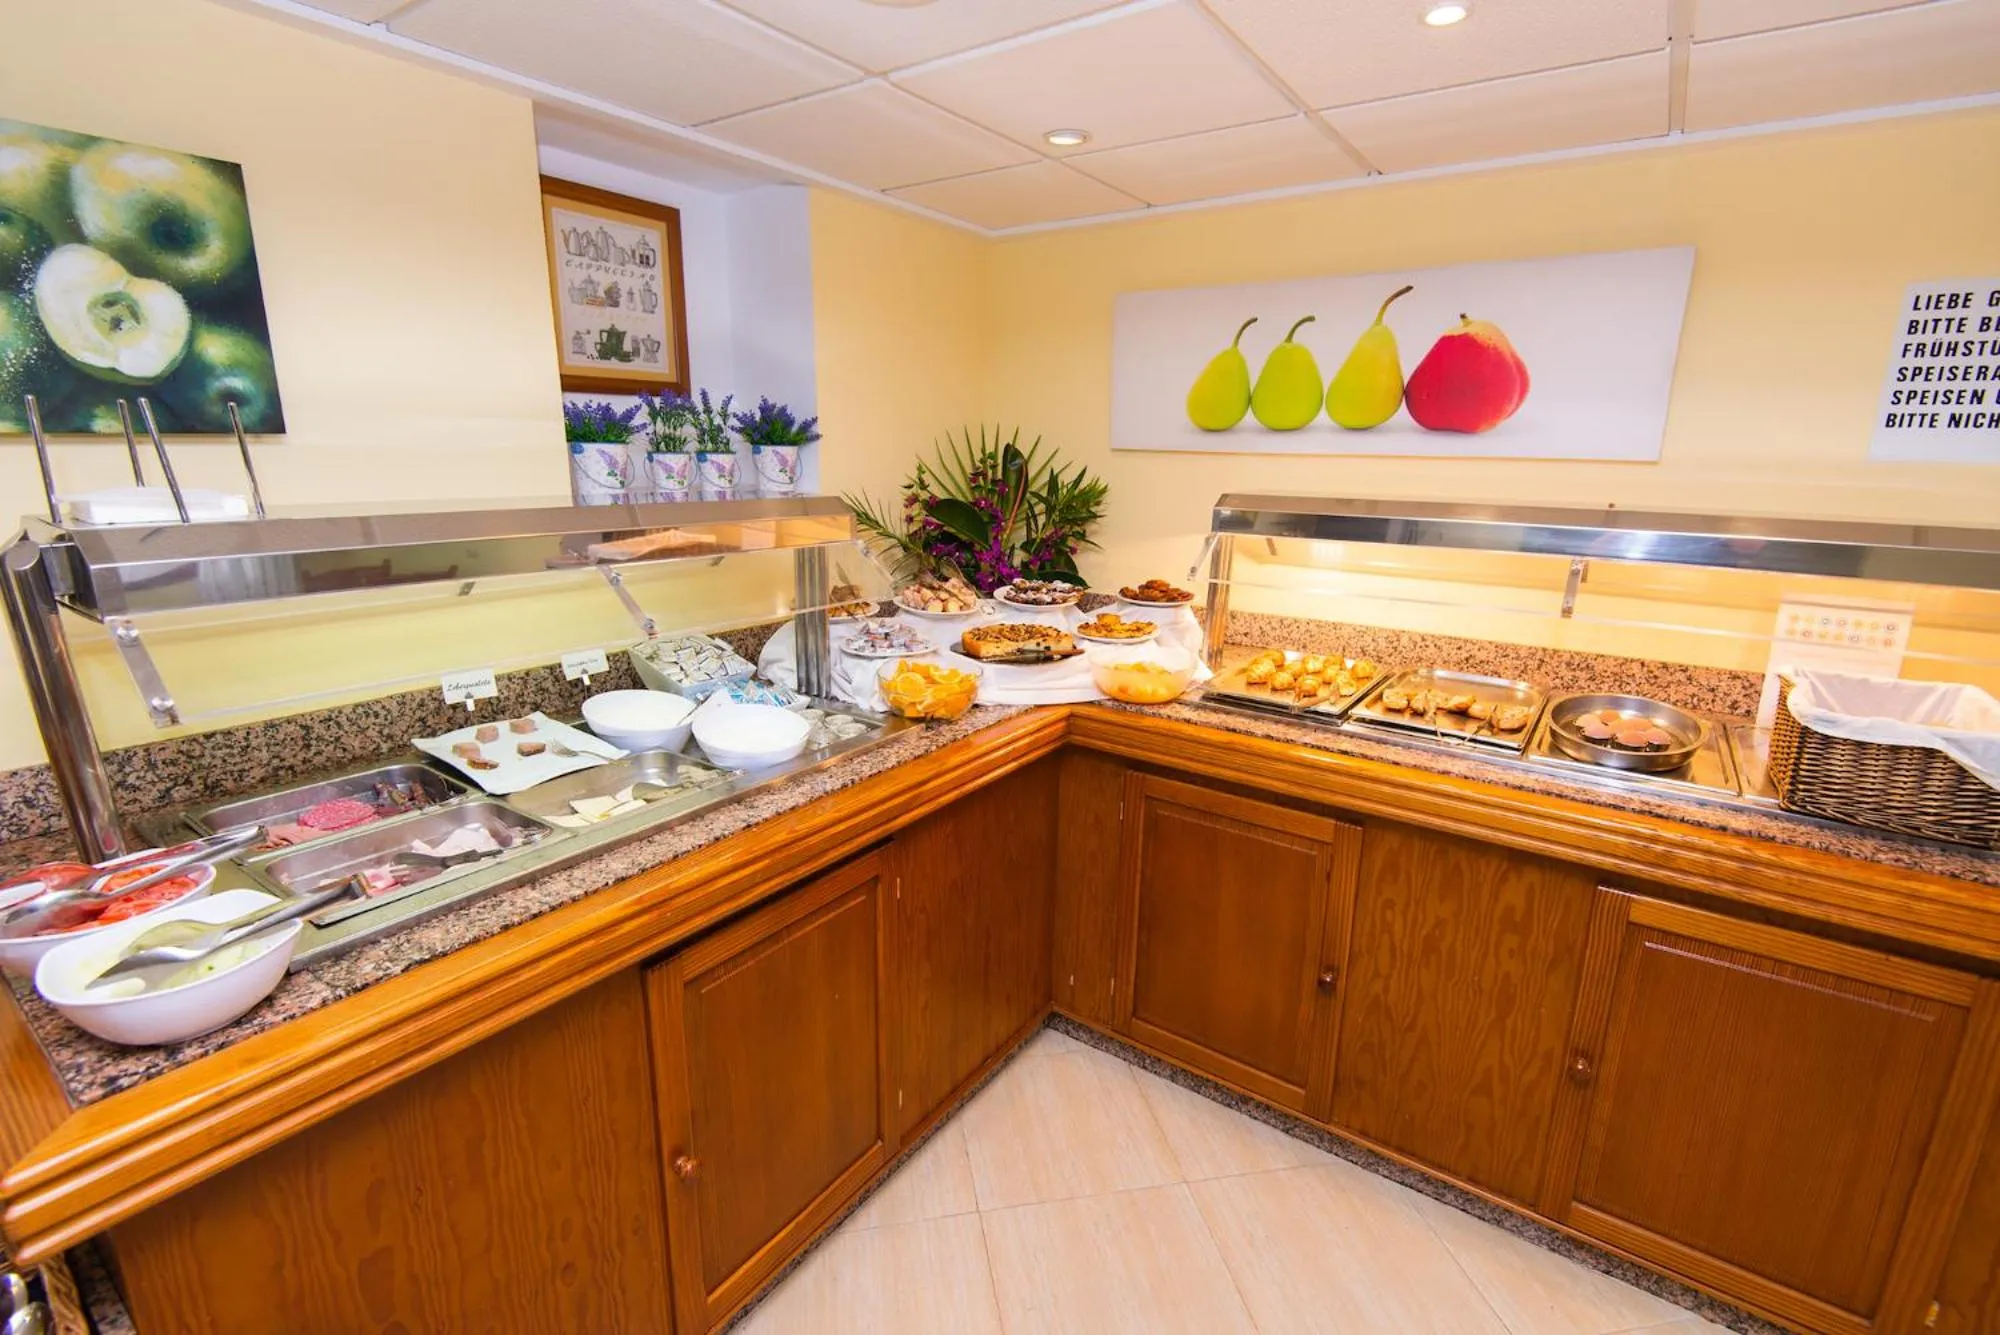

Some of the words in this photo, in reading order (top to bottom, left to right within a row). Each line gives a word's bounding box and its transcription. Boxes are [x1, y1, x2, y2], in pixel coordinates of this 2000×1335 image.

[1912, 291, 1974, 312] LIEBE
[1906, 316, 1969, 336] BITTE
[1890, 388, 1986, 406] SPEISEN
[1884, 412, 1940, 429] BITTE
[1947, 411, 2000, 429] NICH
